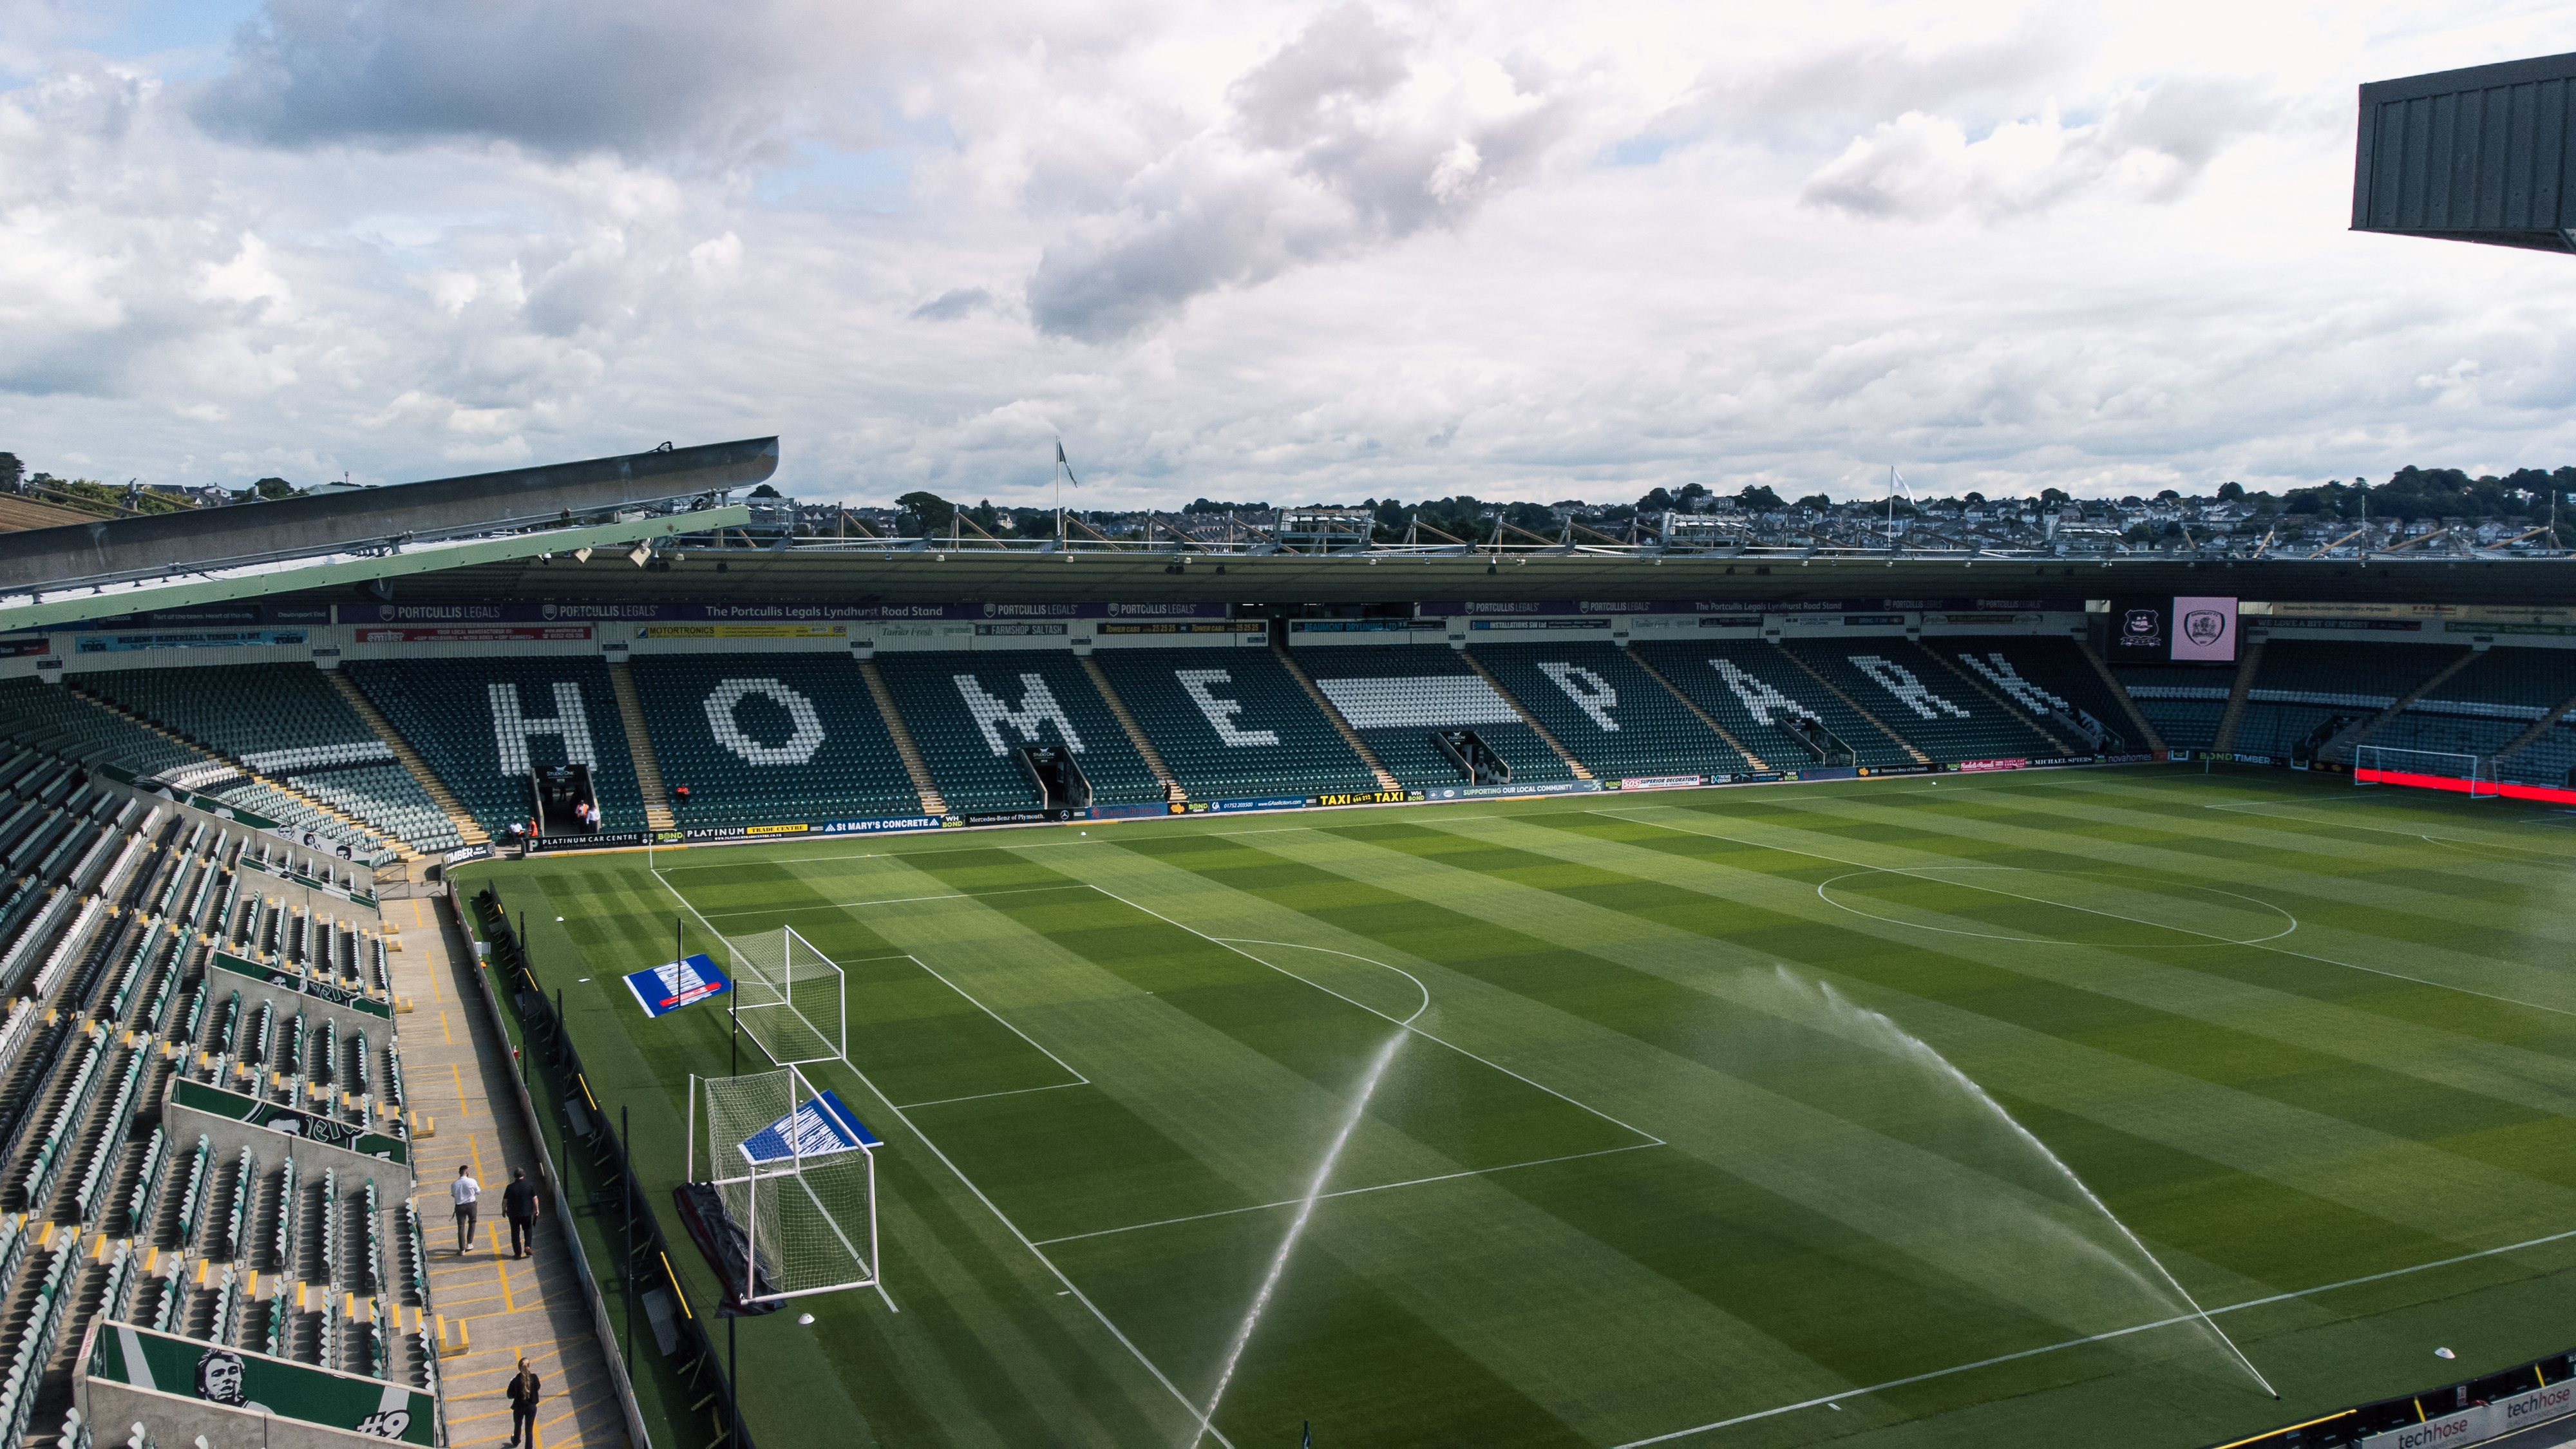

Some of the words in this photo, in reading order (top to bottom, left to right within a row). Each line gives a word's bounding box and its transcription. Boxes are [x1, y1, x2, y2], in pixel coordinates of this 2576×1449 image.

[560, 606, 619, 616] PORTCULLIS
[998, 605, 1046, 614] PORTCULLIS
[1121, 605, 1167, 614] PORTCULLIS
[1476, 603, 1514, 612] PORTCULLIS
[1744, 602, 1766, 611] Legals
[398, 607, 462, 618] PORTCULLIS
[706, 606, 728, 616] The
[732, 606, 782, 616] Portcullis
[786, 607, 821, 618] Legals
[824, 606, 878, 618] Lyndhurst
[882, 606, 909, 616] Road
[912, 606, 943, 616] Stand
[882, 627, 909, 636] Tamar
[992, 626, 1029, 634] FARMSHOP
[1032, 625, 1062, 634] SALTASH
[1304, 623, 1343, 631] BEAUMONT
[118, 636, 153, 644] BUILDING
[1537, 652, 2069, 732] PARK
[488, 668, 1279, 777] HOME
[2108, 753, 2152, 762] novahomes
[2233, 753, 2271, 765] TIMBER
[1623, 780, 1640, 788] SOS
[1463, 788, 1502, 796] SUPPORTING
[1537, 784, 1573, 792] COMMUNITY
[1320, 794, 1350, 805] TAXI
[1374, 791, 1404, 802] TAXI
[848, 820, 880, 831] MARY'S
[882, 819, 928, 828] CONCRETE
[687, 828, 744, 837] PLATINUM
[446, 847, 473, 864] TIMBER
[2508, 1388, 2570, 1419] techhose
[356, 1410, 412, 1440] #9
[2399, 1419, 2468, 1449] techhose
